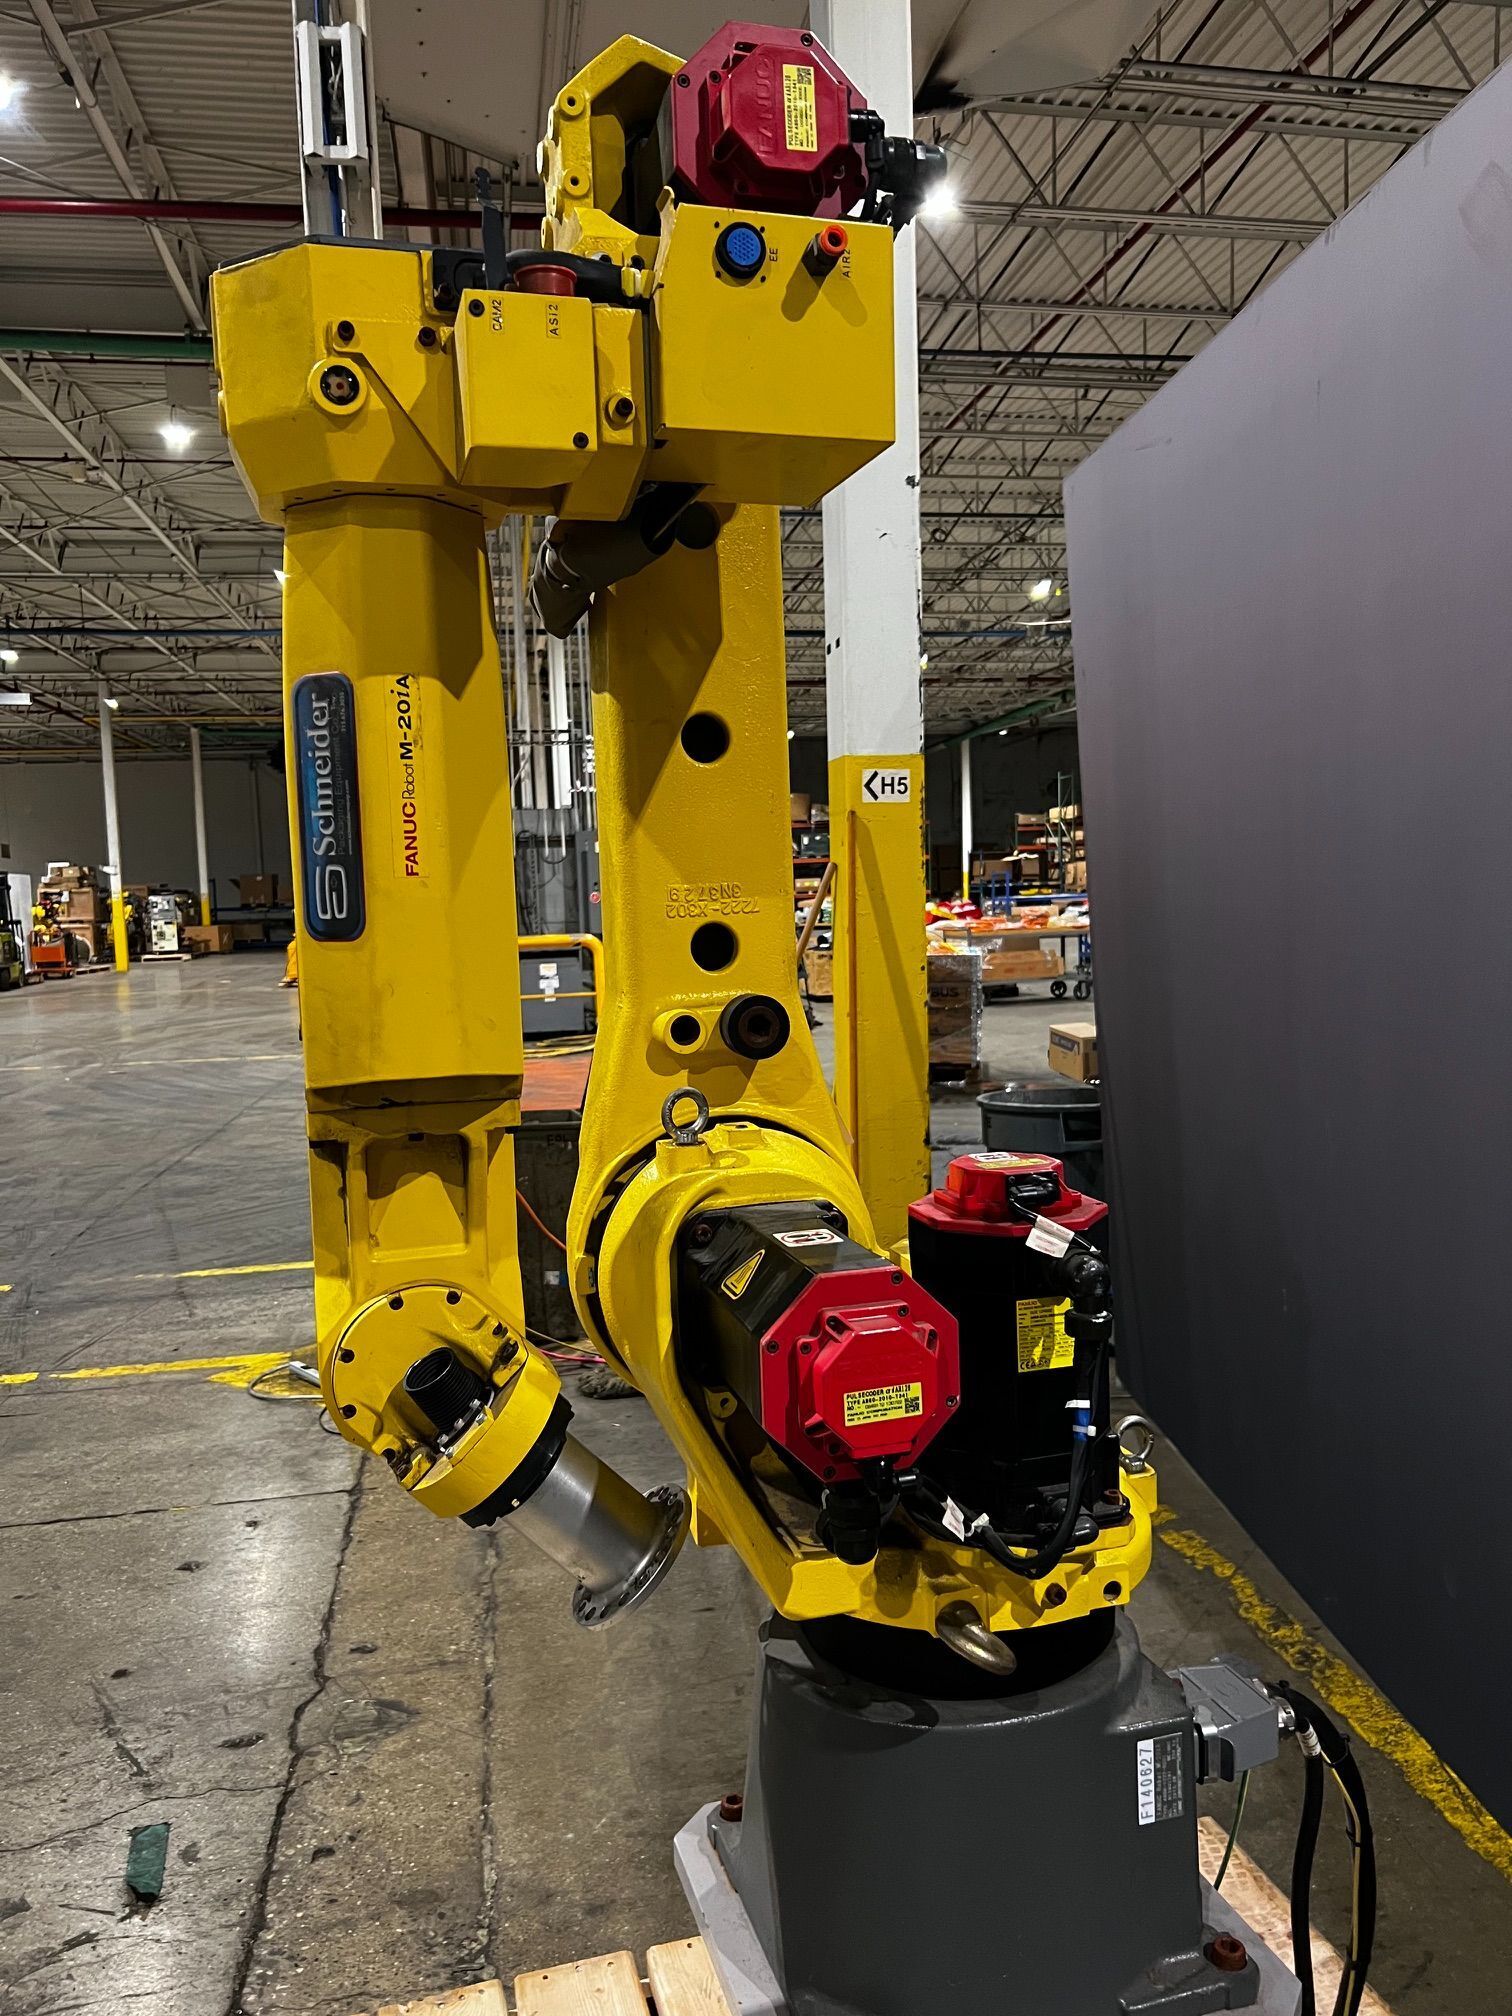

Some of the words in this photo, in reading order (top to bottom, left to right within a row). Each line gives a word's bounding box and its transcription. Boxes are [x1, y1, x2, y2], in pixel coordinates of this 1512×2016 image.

[769, 247, 778, 262] EE
[840, 248, 851, 278] AIR2
[492, 299, 502, 331] CAM2
[390, 674, 413, 760] M-20iA
[306, 692, 337, 856] Schneider
[332, 737, 344, 795] Equipment
[402, 764, 415, 800] Robot
[881, 776, 908, 795] H5
[401, 802, 419, 877] FANUC
[666, 897, 760, 918] 7222-X302
[846, 1388, 884, 1400] PULSECODER
[847, 1399, 860, 1407] TYPE
[1140, 1748, 1153, 1819] F140627
